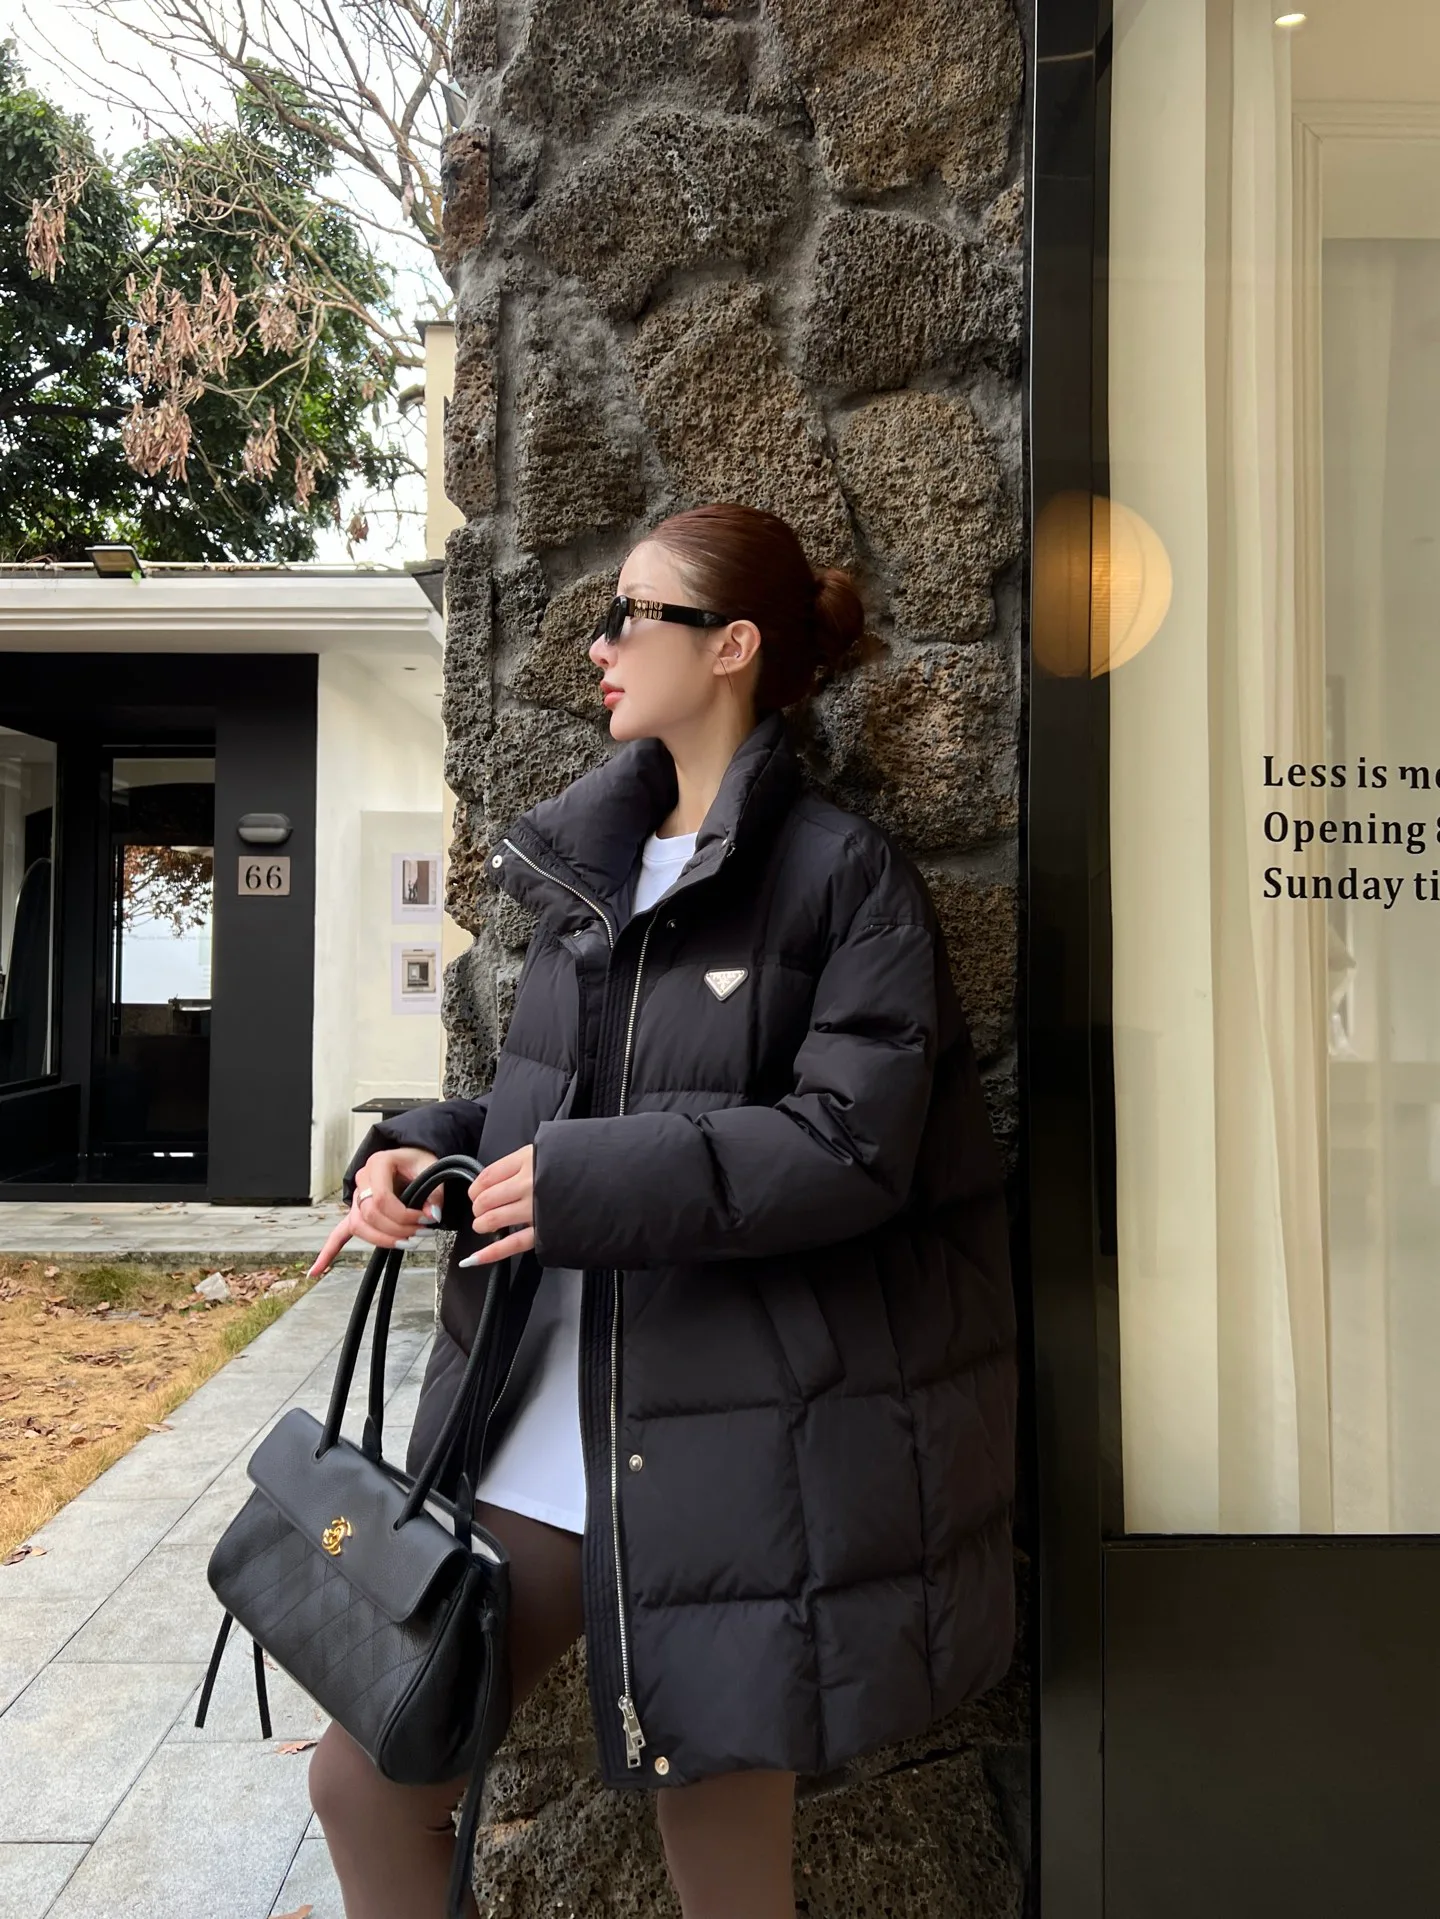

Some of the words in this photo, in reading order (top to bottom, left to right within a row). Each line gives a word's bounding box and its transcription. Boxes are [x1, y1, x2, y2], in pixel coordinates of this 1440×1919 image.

[1263, 755, 1346, 787] Less
[1357, 757, 1387, 788] is
[1398, 766, 1440, 789] m
[1264, 811, 1426, 854] Opening
[245, 865, 282, 889] 66
[1263, 867, 1404, 909] Sunday
[1414, 870, 1440, 900] ti
